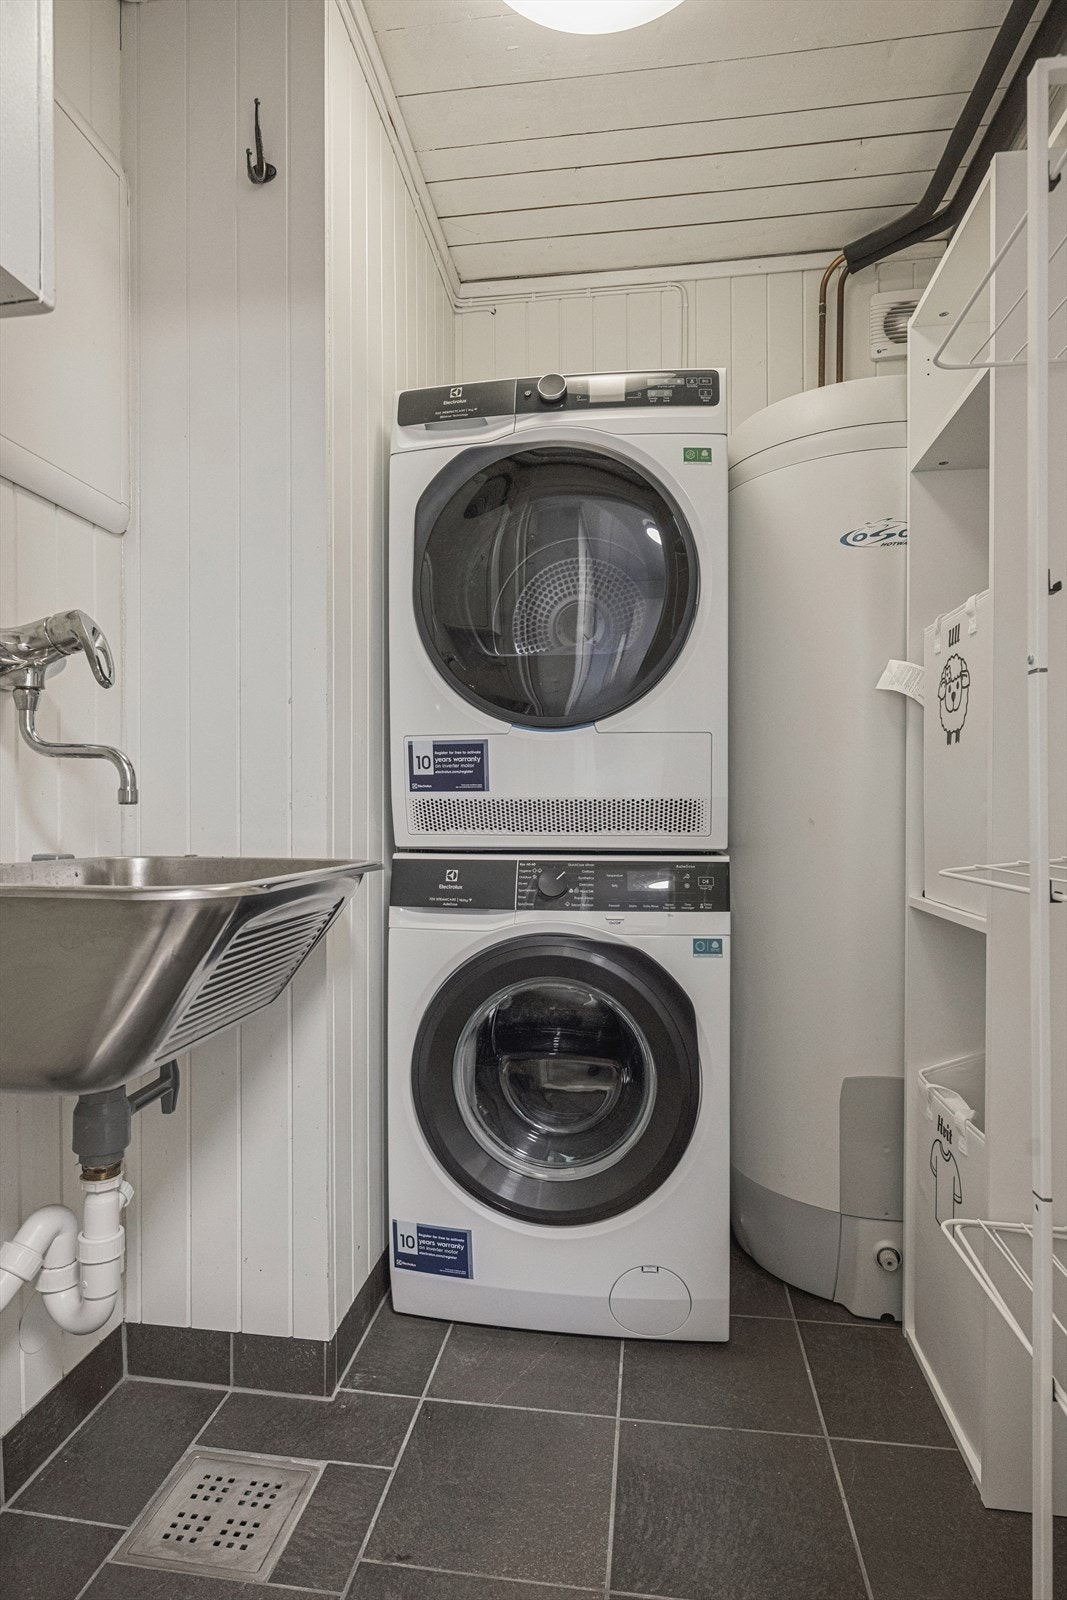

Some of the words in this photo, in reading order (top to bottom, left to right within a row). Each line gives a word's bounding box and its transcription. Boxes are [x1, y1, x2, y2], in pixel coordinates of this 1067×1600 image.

[415, 755, 432, 770] 10
[937, 1114, 952, 1144] Hvit
[400, 1234, 415, 1249] 10
[436, 1240, 465, 1251] warranty
